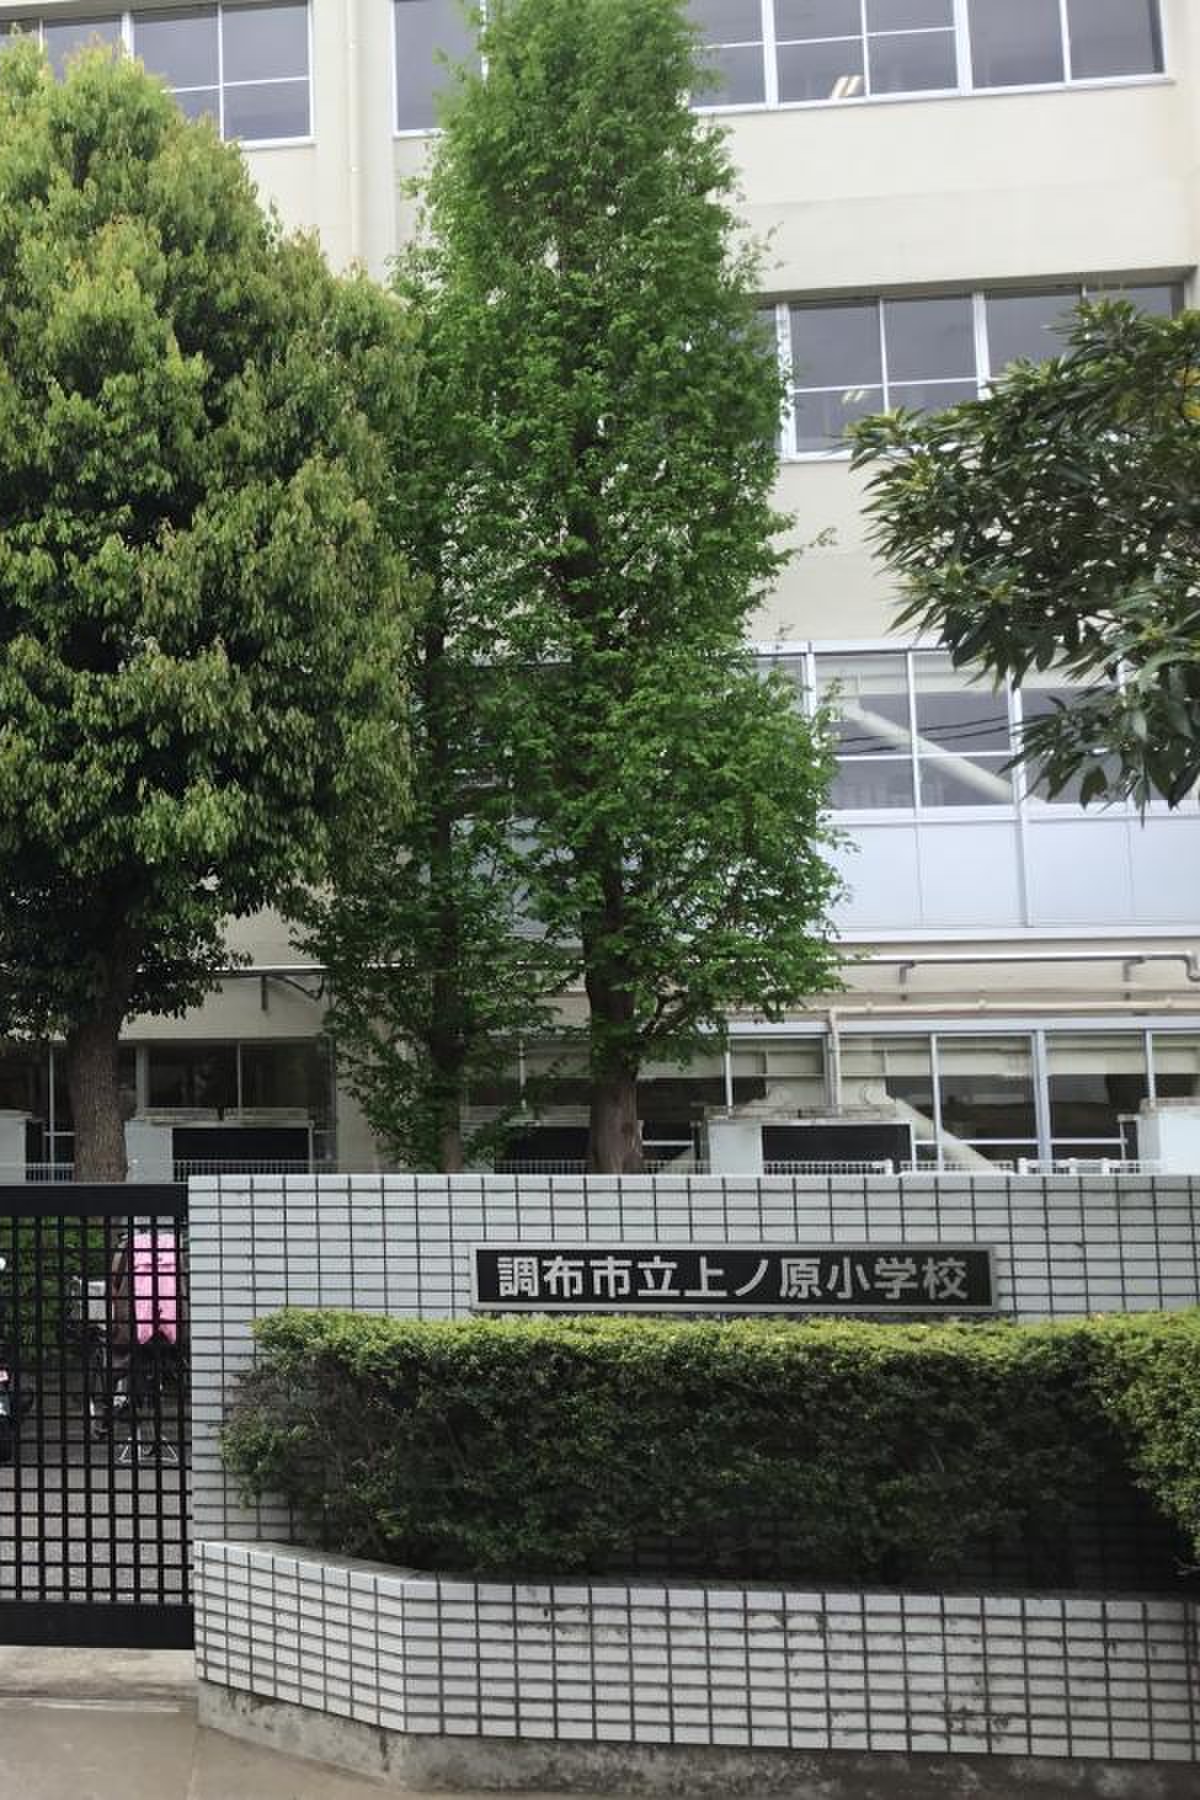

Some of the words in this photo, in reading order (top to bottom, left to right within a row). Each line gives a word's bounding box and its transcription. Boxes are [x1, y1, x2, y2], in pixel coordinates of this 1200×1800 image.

[497, 1256, 969, 1299] 調布市立上ノ原小学校
